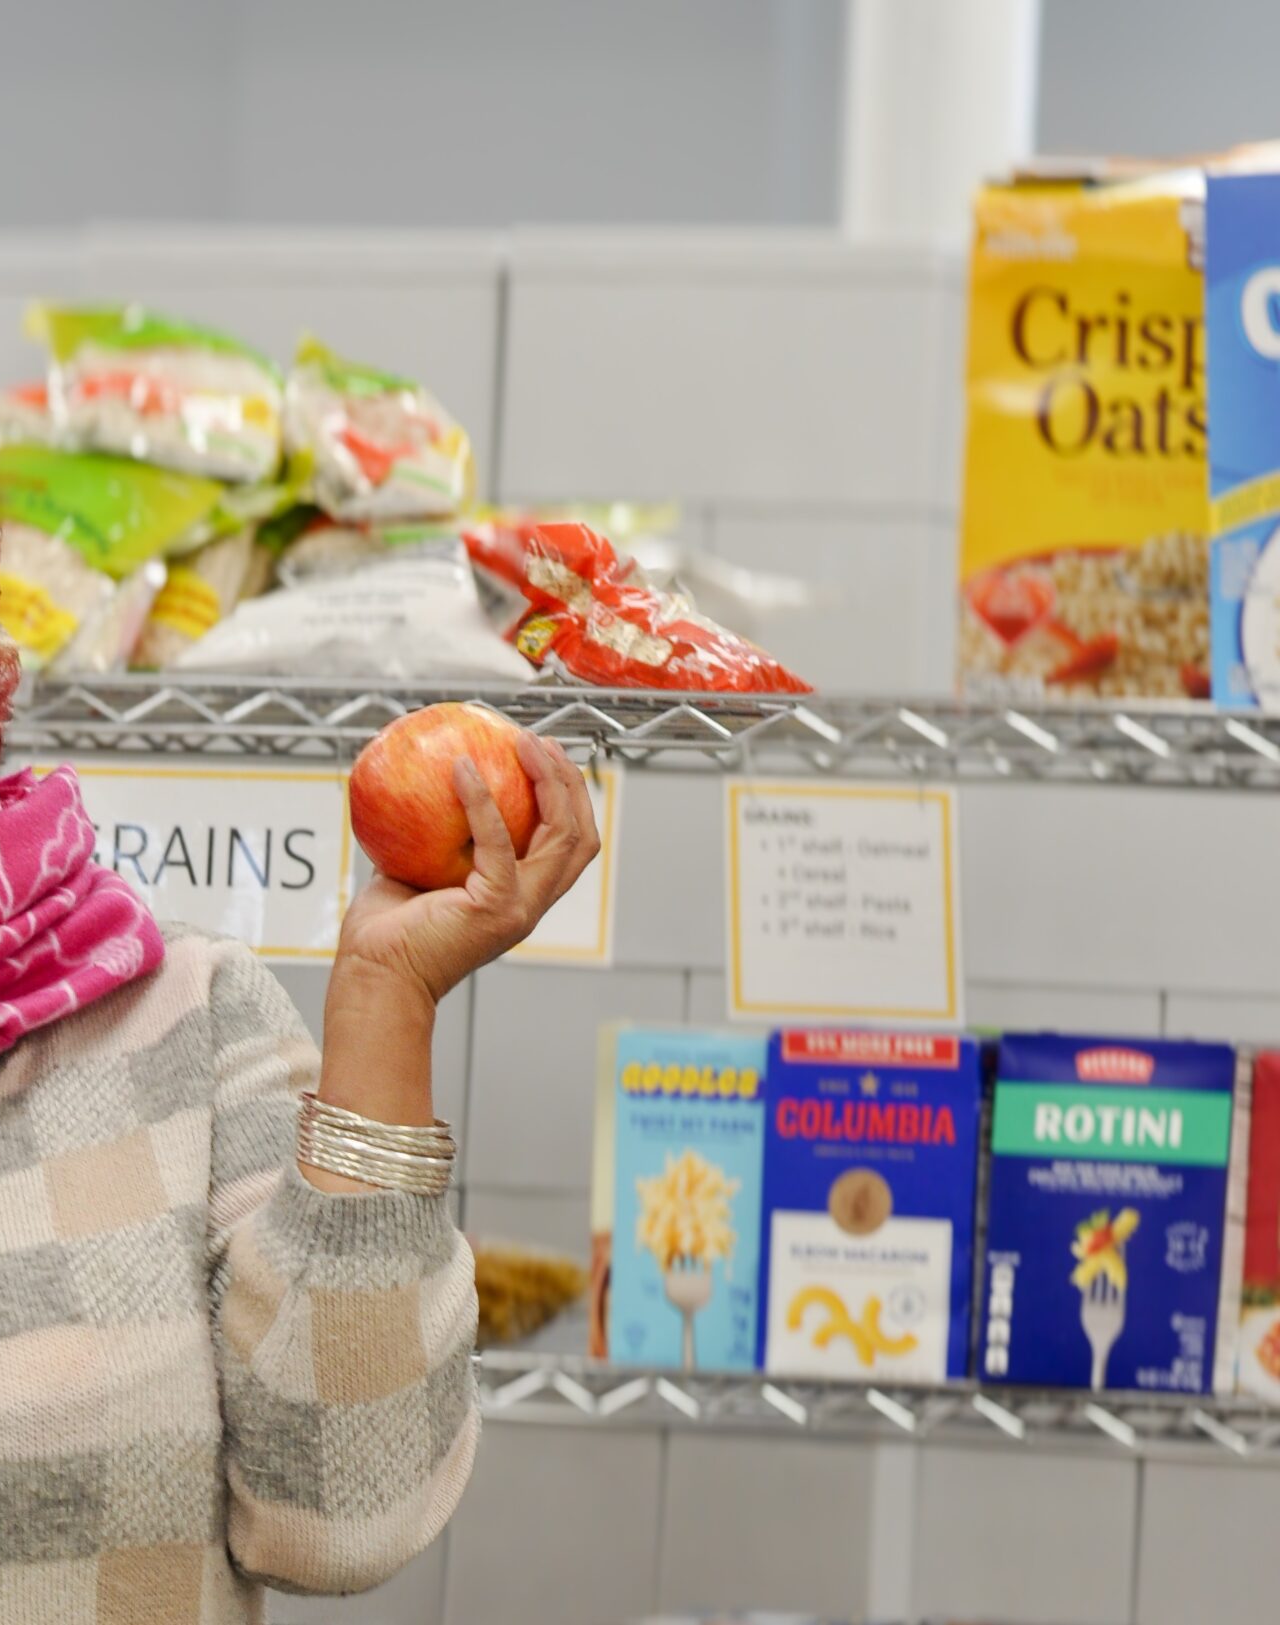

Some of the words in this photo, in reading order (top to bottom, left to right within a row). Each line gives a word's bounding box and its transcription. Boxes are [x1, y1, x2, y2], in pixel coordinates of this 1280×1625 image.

[93, 825, 316, 889] RAINS
[776, 1098, 956, 1146] COLUMBIA
[1034, 1102, 1183, 1148] ROTINI
